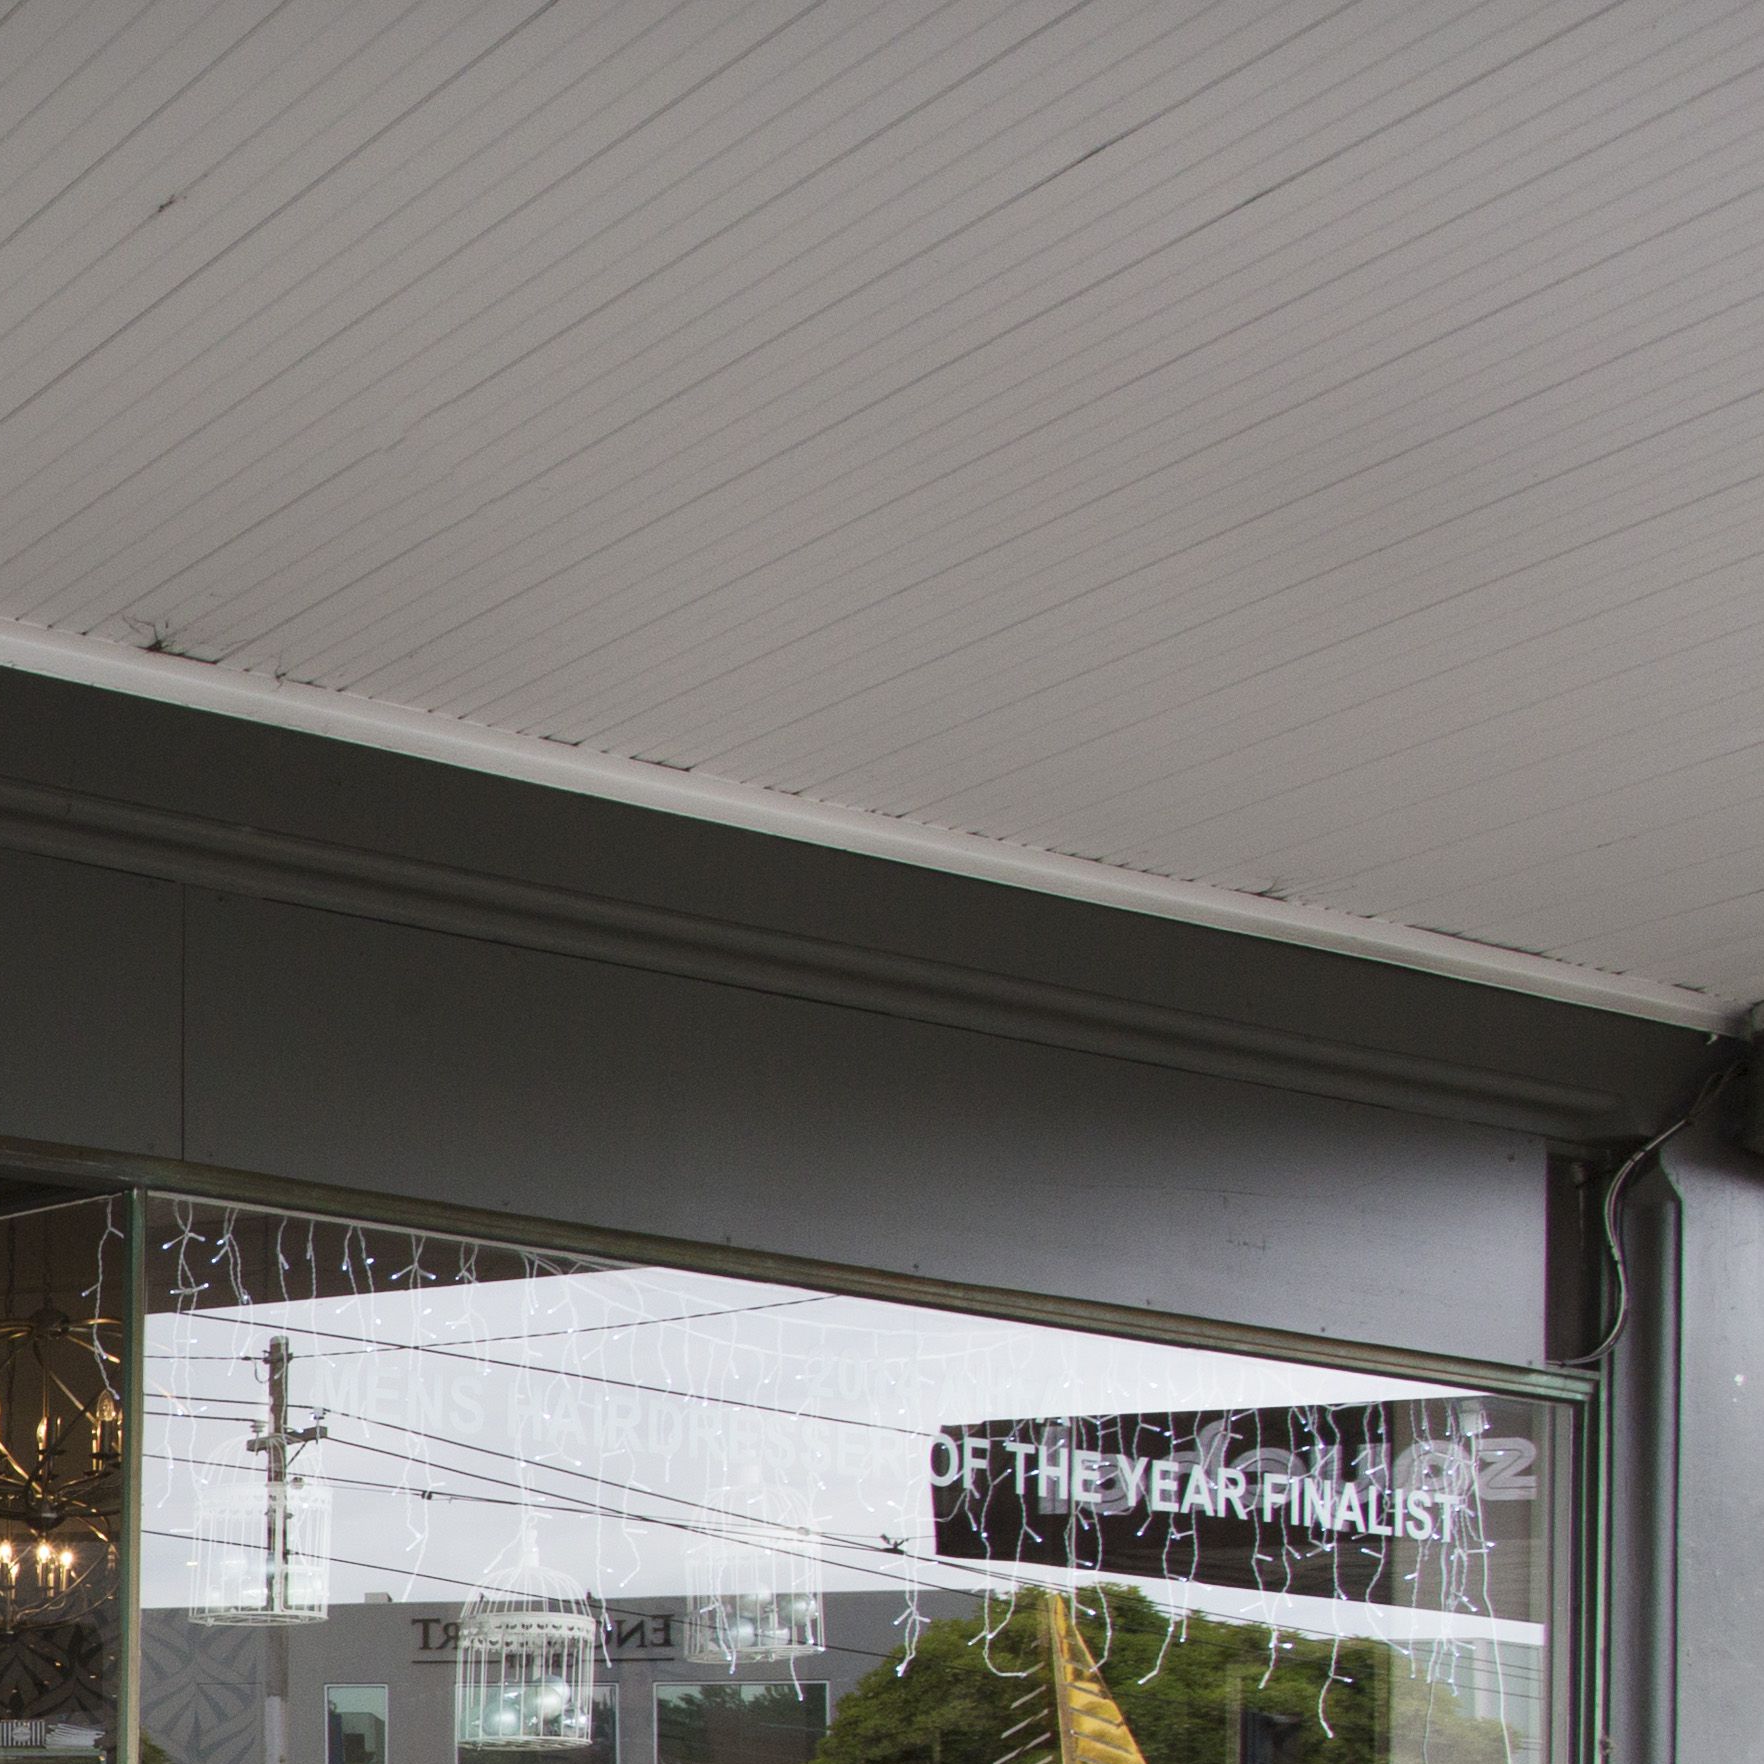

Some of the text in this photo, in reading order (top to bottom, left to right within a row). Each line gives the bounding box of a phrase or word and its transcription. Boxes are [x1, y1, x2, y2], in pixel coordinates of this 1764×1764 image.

[928, 1433, 988, 1488] OF
[1007, 1443, 1103, 1504] THE
[1119, 1456, 1248, 1522] YEAR
[1263, 1472, 1463, 1545] FINALIST
